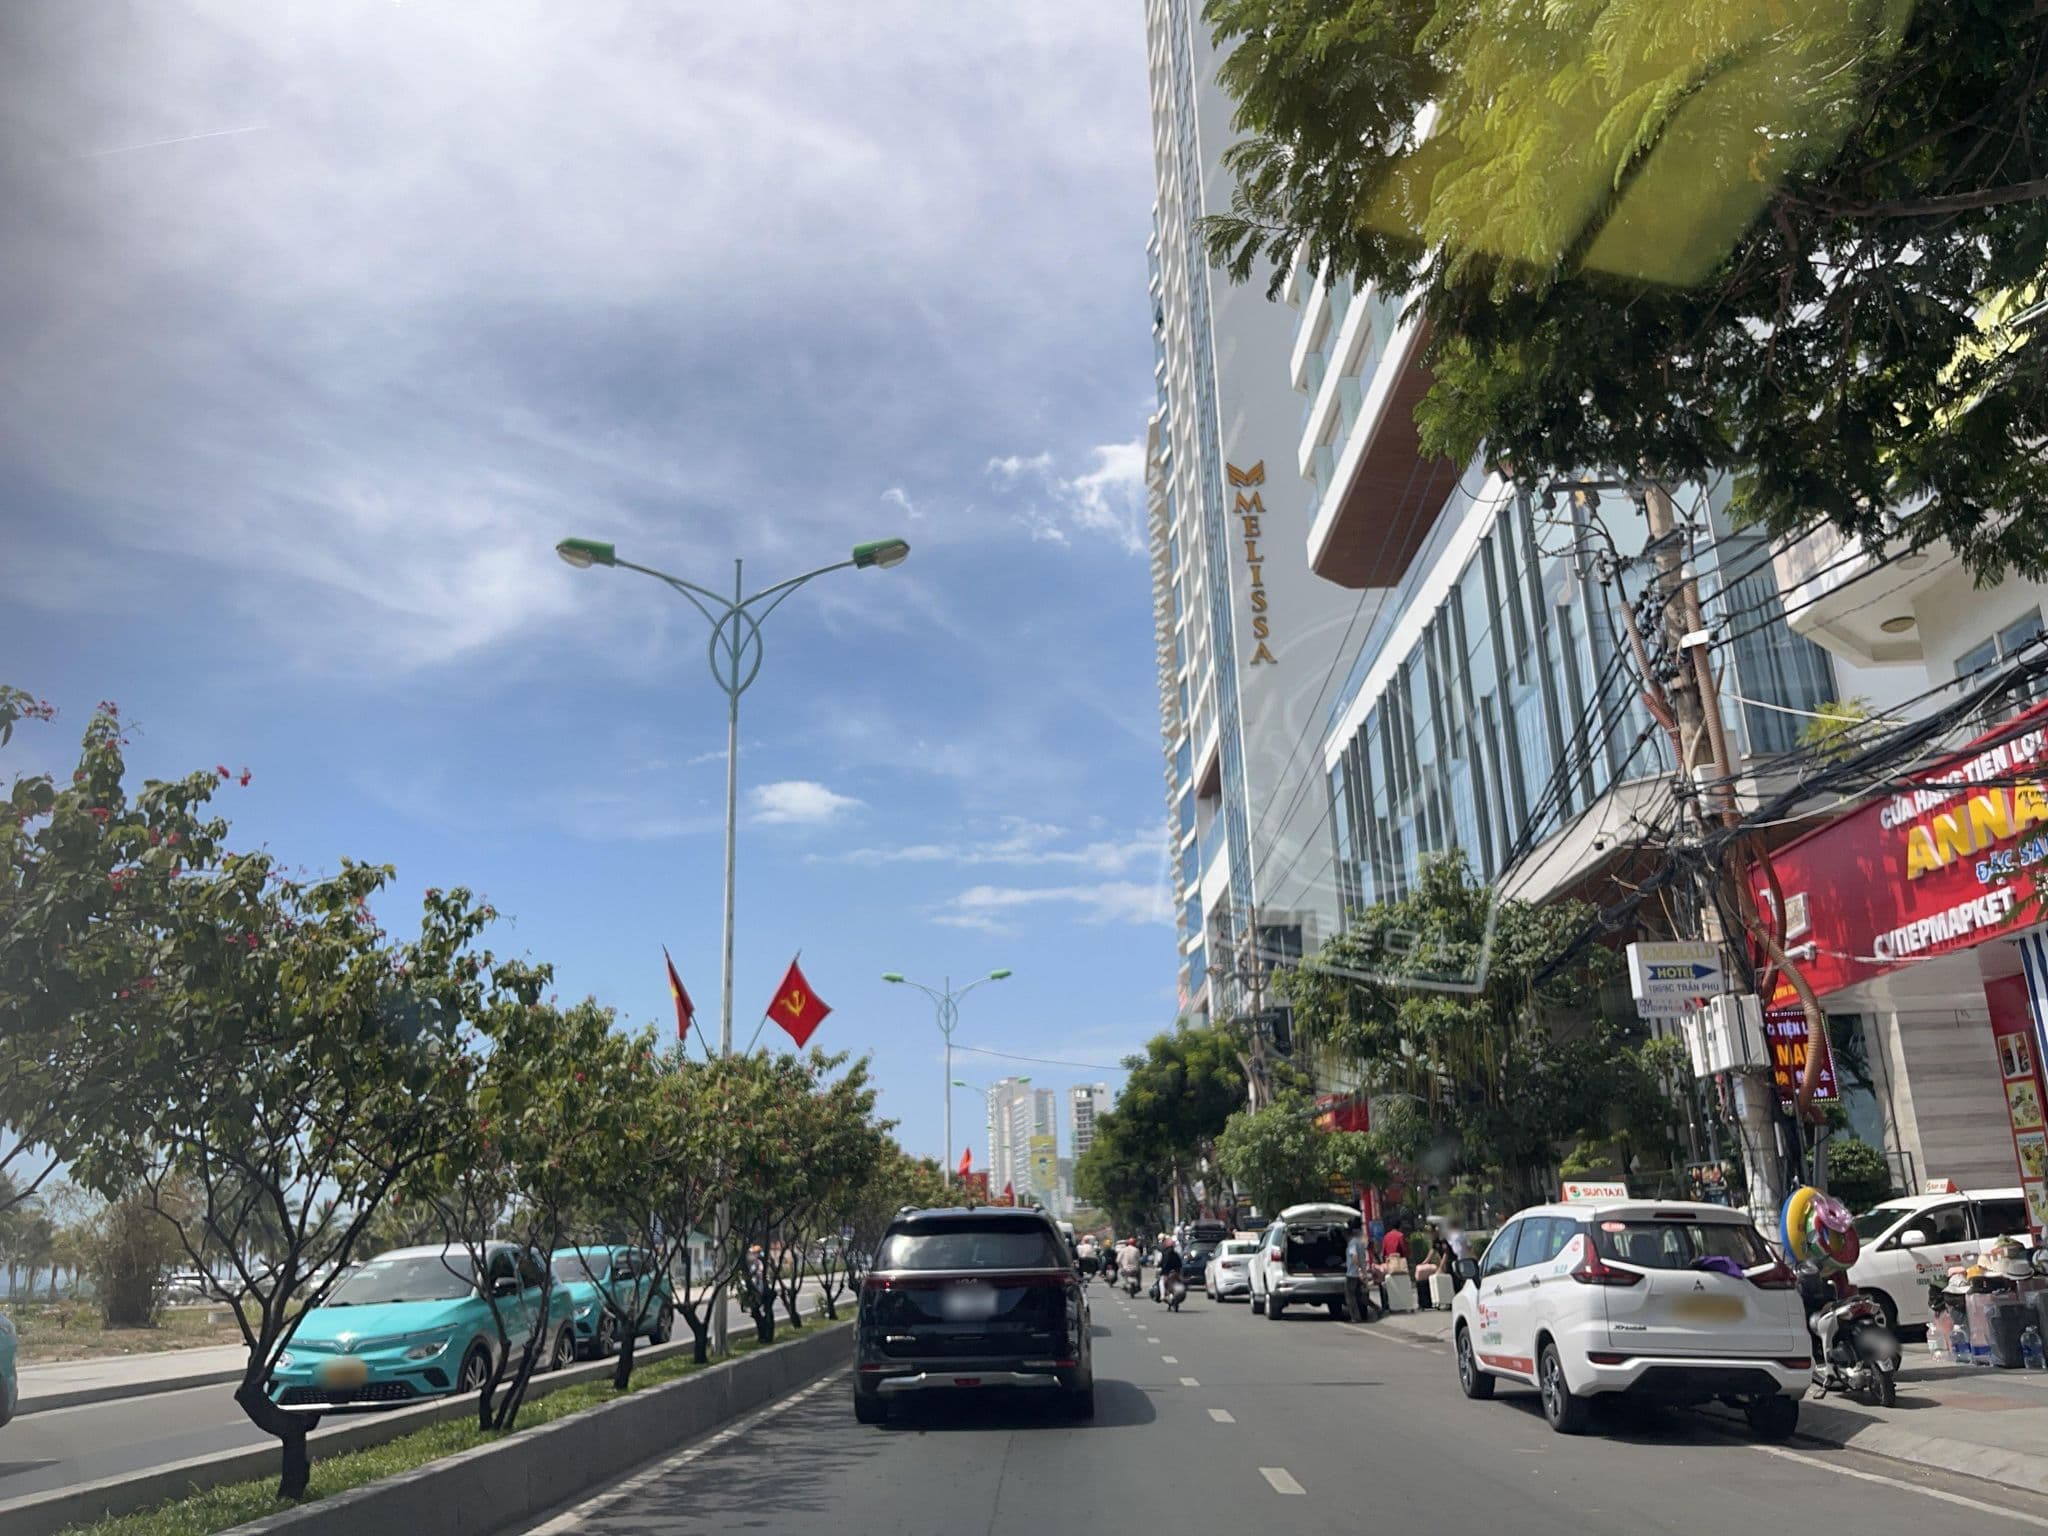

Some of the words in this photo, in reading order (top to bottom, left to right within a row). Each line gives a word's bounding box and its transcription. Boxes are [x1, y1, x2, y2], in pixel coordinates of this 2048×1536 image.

[1233, 491, 1278, 665] MELISSA
[1873, 886, 2014, 961] СУПЕРМАРКЕТ
[1656, 965, 1696, 979] HOTEL
